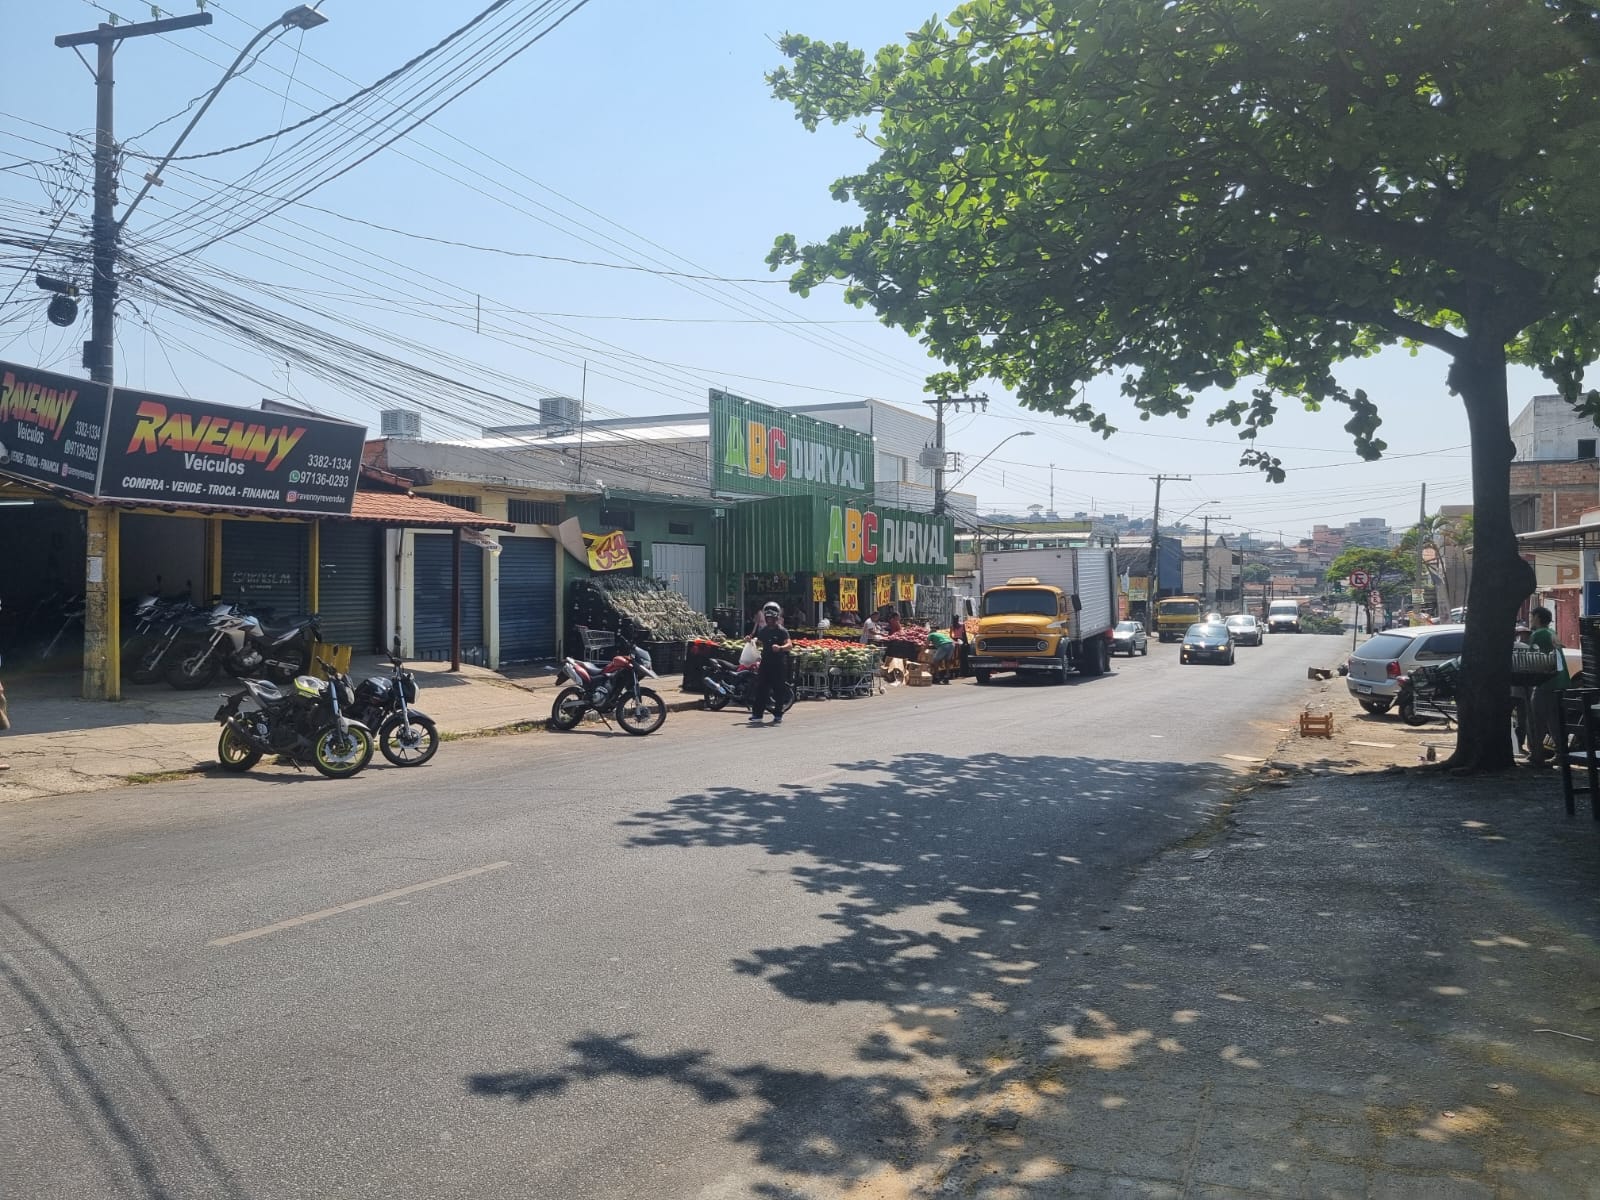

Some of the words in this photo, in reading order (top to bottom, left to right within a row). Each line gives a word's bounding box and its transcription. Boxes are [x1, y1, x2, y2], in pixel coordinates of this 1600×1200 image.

[126, 400, 307, 471] RAVENNY
[184, 452, 245, 475] Veículos
[307, 454, 352, 471] 3382-1334
[724, 416, 787, 481] ABC
[791, 437, 865, 490] DURVAL
[122, 476, 167, 491] COMPRA
[172, 479, 202, 494] VENDE
[208, 484, 237, 497] TROCA
[241, 487, 280, 501] FINANCIA
[300, 470, 349, 487] 97136-0293
[827, 505, 878, 565] ABC
[883, 518, 948, 565] DURVAL
